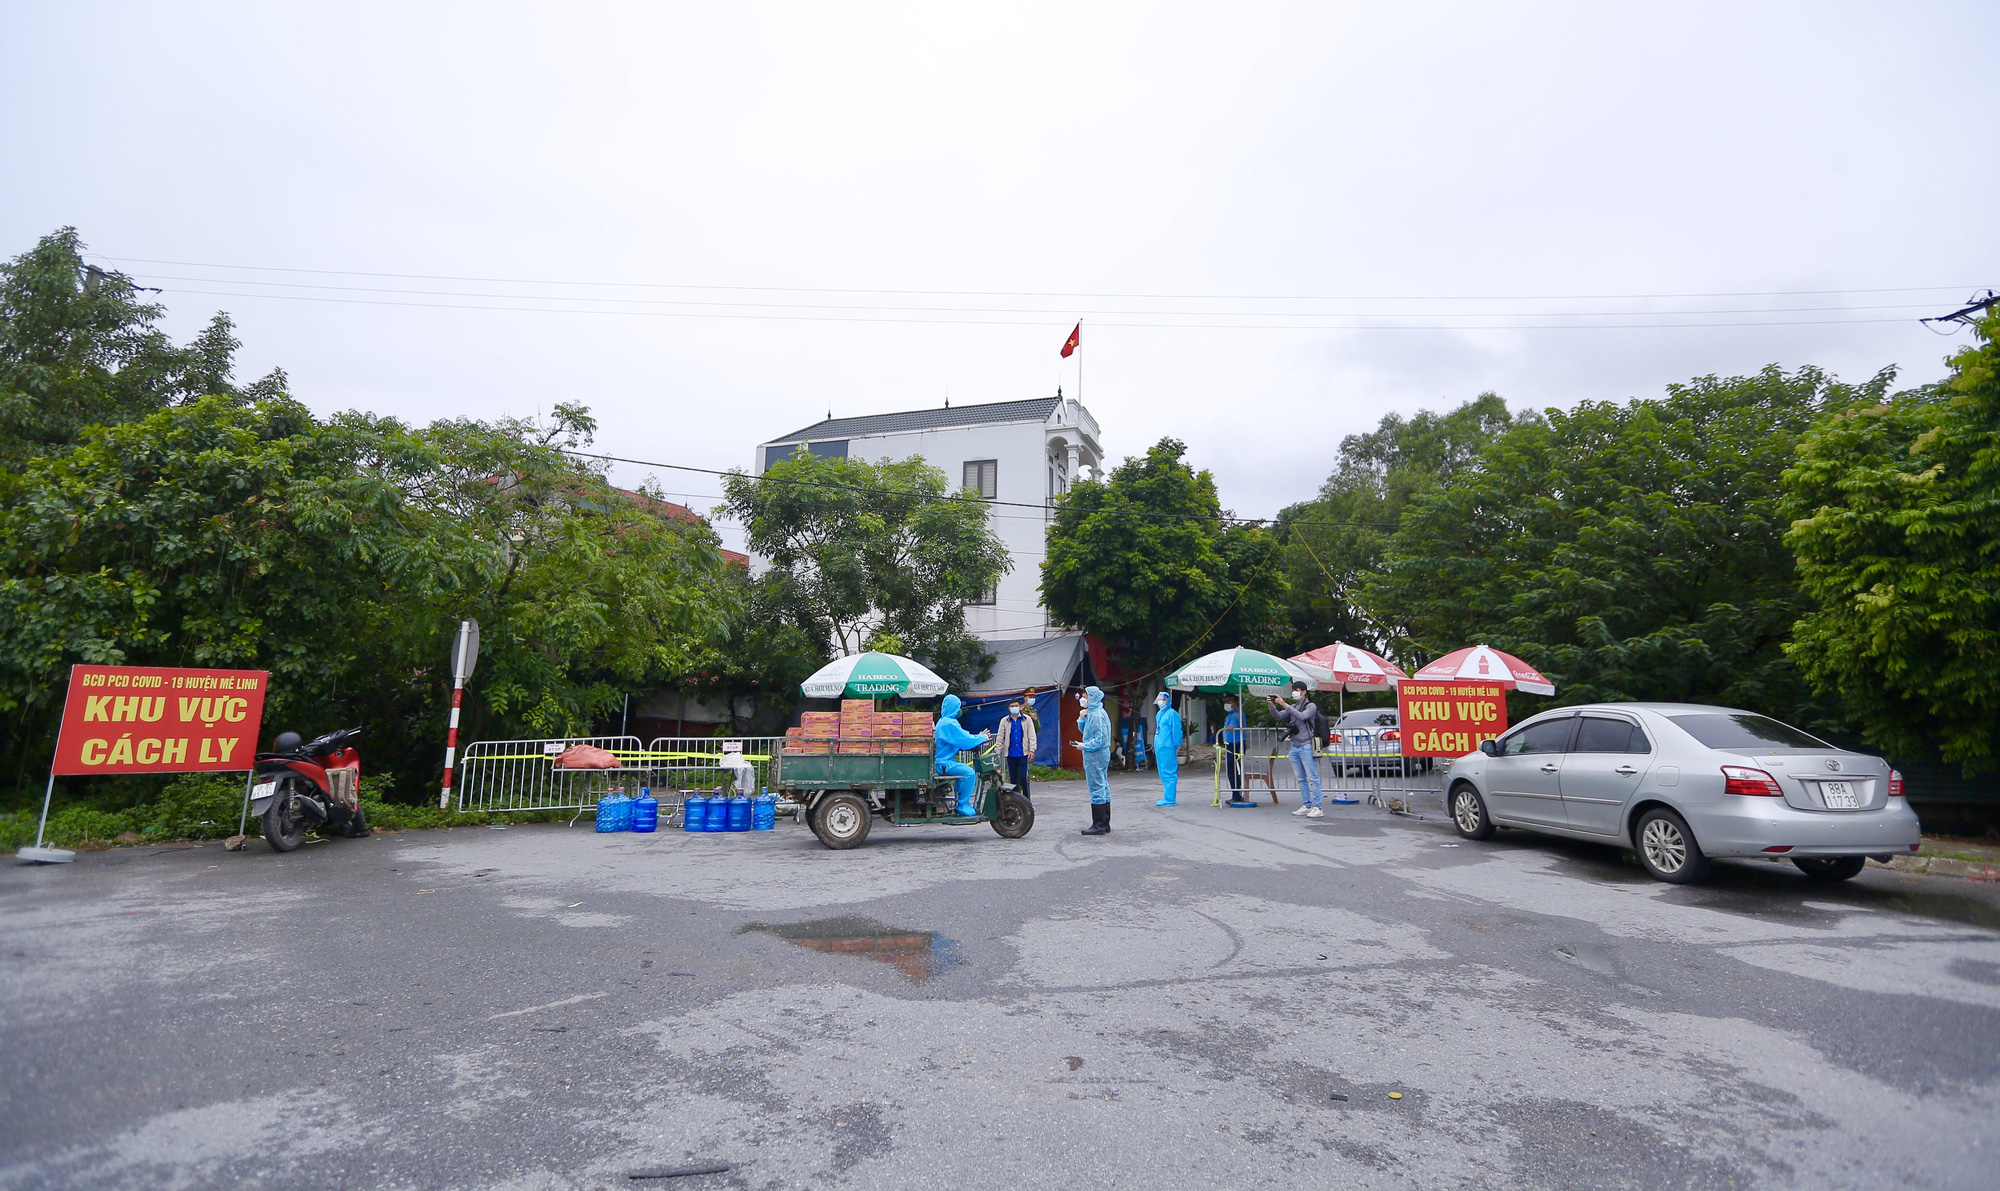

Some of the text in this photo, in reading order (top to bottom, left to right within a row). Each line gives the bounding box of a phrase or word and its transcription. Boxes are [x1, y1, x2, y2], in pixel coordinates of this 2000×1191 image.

[82, 674, 105, 687] BCĐ
[107, 675, 128, 688] PCD
[131, 676, 162, 688] COVID
[171, 677, 183, 689] 19
[185, 675, 218, 691] HUYỆN
[219, 676, 235, 690] MÊ
[236, 678, 258, 690] LINH
[855, 684, 900, 692] TRADING
[1238, 675, 1281, 684] TRADING
[1429, 686, 1445, 696] COVID
[1450, 687, 1457, 696] 19
[1457, 685, 1476, 698] HUYỆN
[1476, 686, 1486, 696] MÊ
[1486, 687, 1499, 697] LINH
[83, 695, 248, 728] KHU VỰC
[1408, 700, 1498, 726] KHU VỰC
[1413, 728, 1470, 752] CÁCH
[80, 733, 240, 766] CÁCH LY
[1828, 783, 1847, 795] 88A
